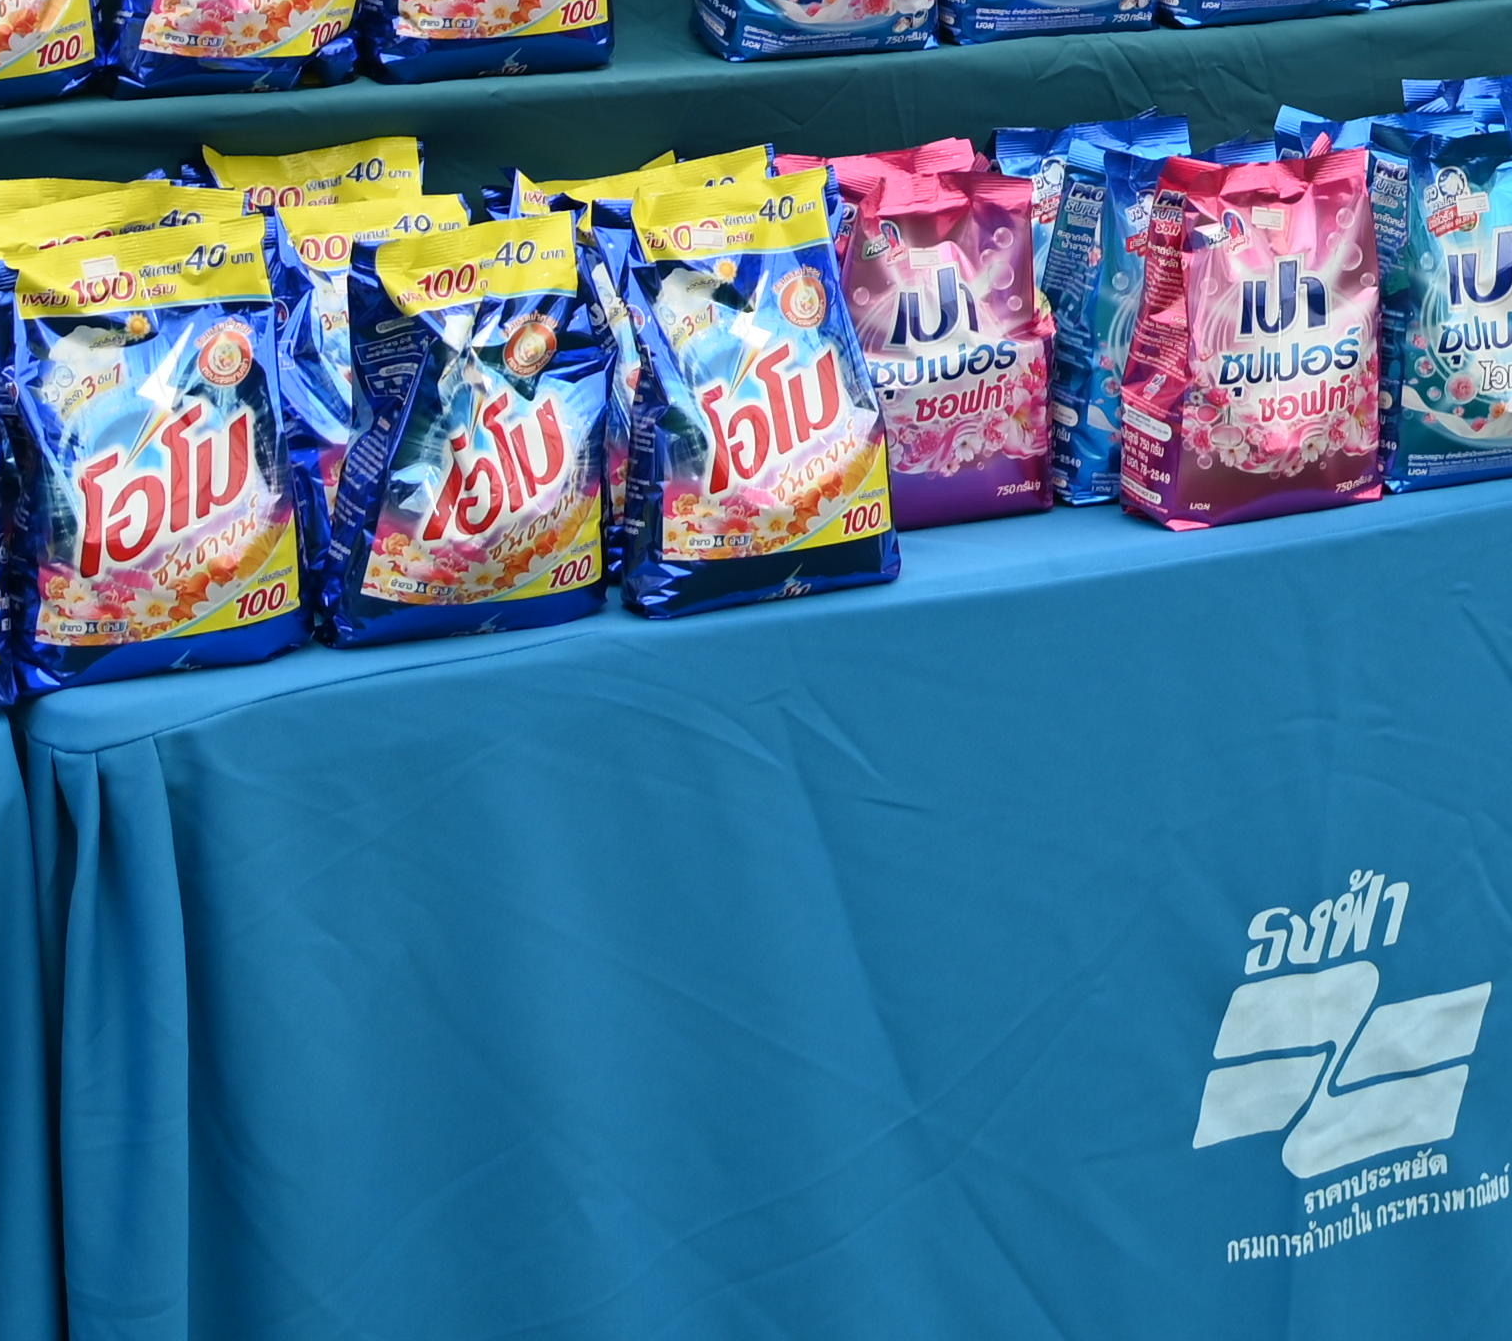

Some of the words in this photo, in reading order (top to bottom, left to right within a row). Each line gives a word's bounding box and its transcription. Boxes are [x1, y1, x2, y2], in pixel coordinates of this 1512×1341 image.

[70, 272, 138, 305] 100
[185, 243, 227, 271] 40
[231, 250, 255, 265] บาท
[890, 265, 977, 345] เปา
[82, 377, 97, 400] 3
[112, 362, 123, 386] 1
[915, 375, 1011, 424] ซอฟท์
[1259, 374, 1351, 423] ซอฟท์
[840, 501, 883, 536] 100
[1189, 501, 1211, 511] LION
[235, 584, 287, 621] 100
[1244, 868, 1410, 975] ธงฟ้า
[1304, 1147, 1448, 1214] ราคาประหยัด
[1227, 1203, 1373, 1264] กรมการค้าภายใน
[1376, 1162, 1511, 1228] กระทรวงพาณิชย์
